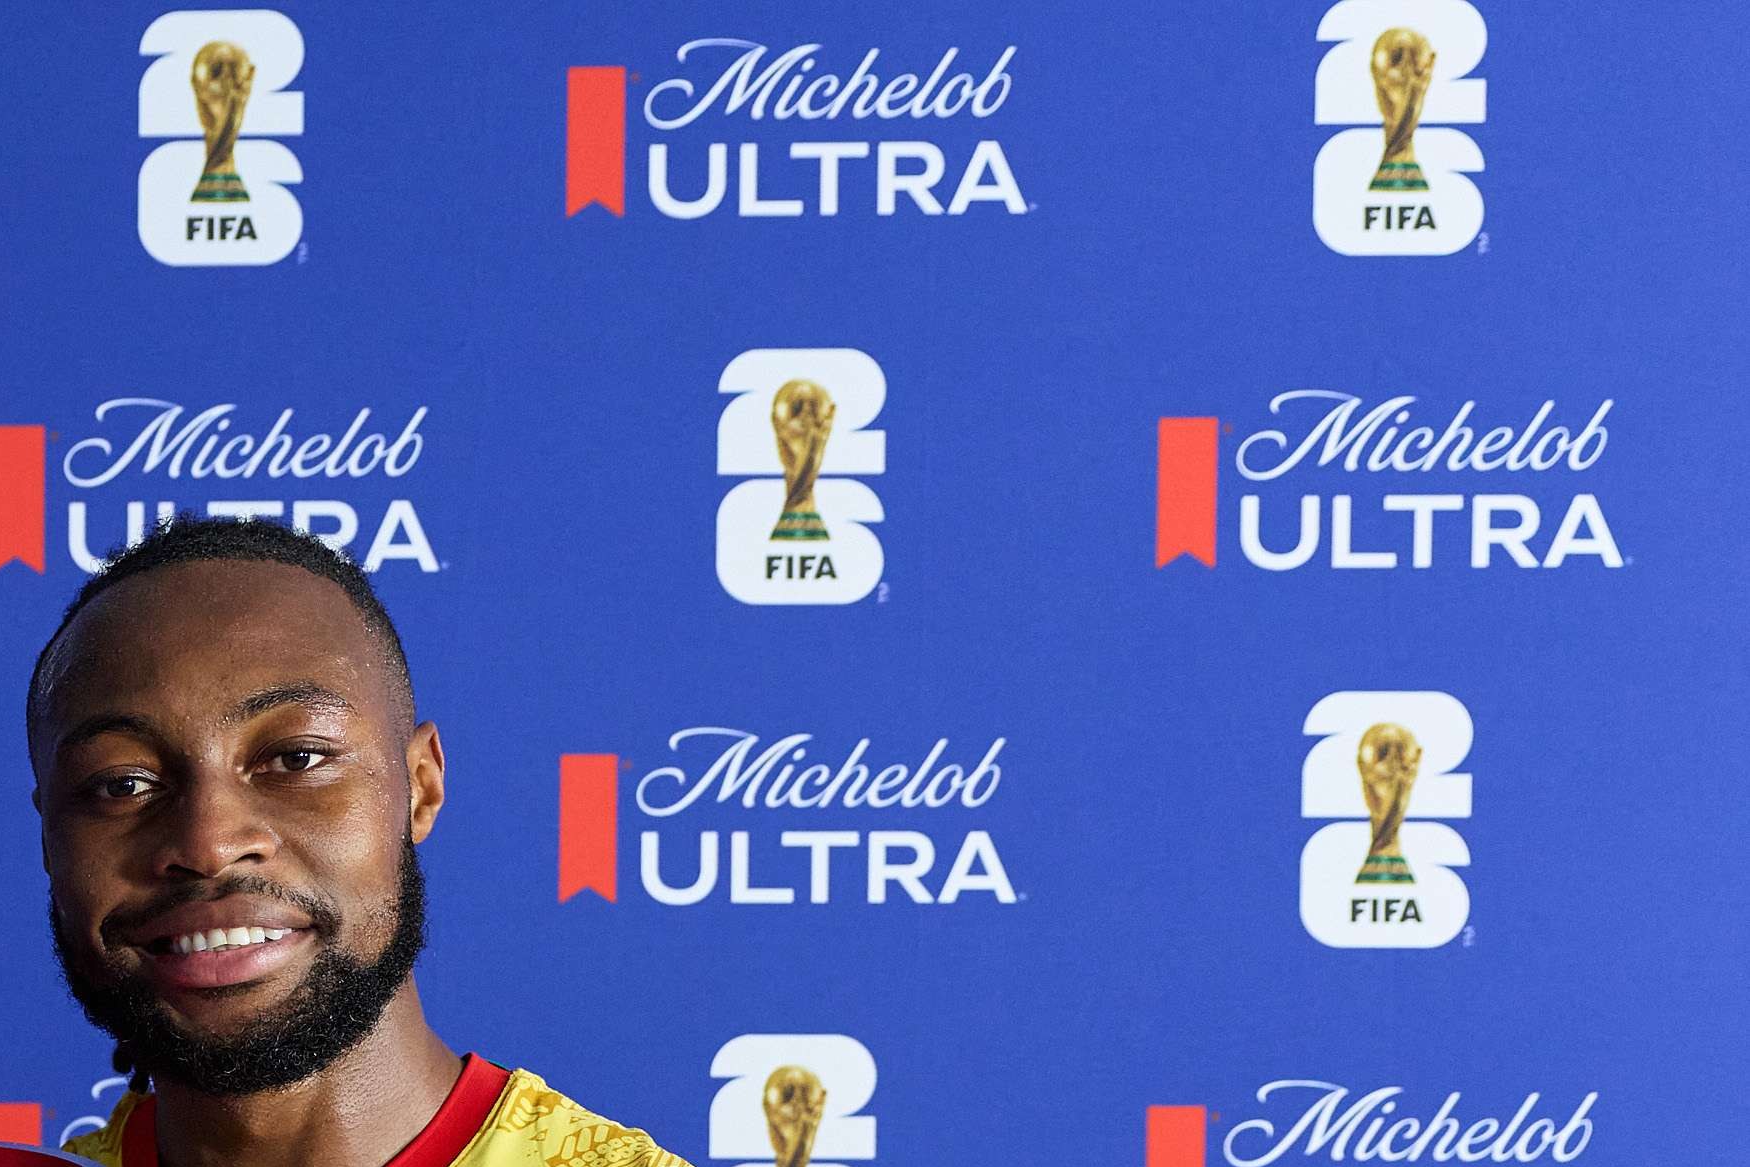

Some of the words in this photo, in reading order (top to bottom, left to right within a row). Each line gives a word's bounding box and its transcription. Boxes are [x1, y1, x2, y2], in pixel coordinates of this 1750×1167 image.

[644, 39, 1016, 129] Michelob
[649, 141, 1028, 219] ULTRA
[1364, 205, 1436, 231] FIFA
[186, 216, 258, 241] FIFA
[64, 398, 427, 487] Michelob
[1236, 390, 1613, 480] Michelob
[766, 555, 837, 580] FIFA
[1240, 494, 1623, 571] ULTRA
[636, 727, 1005, 816] Michelob
[641, 831, 1017, 905] ULTRA
[1350, 898, 1422, 923] FIFA
